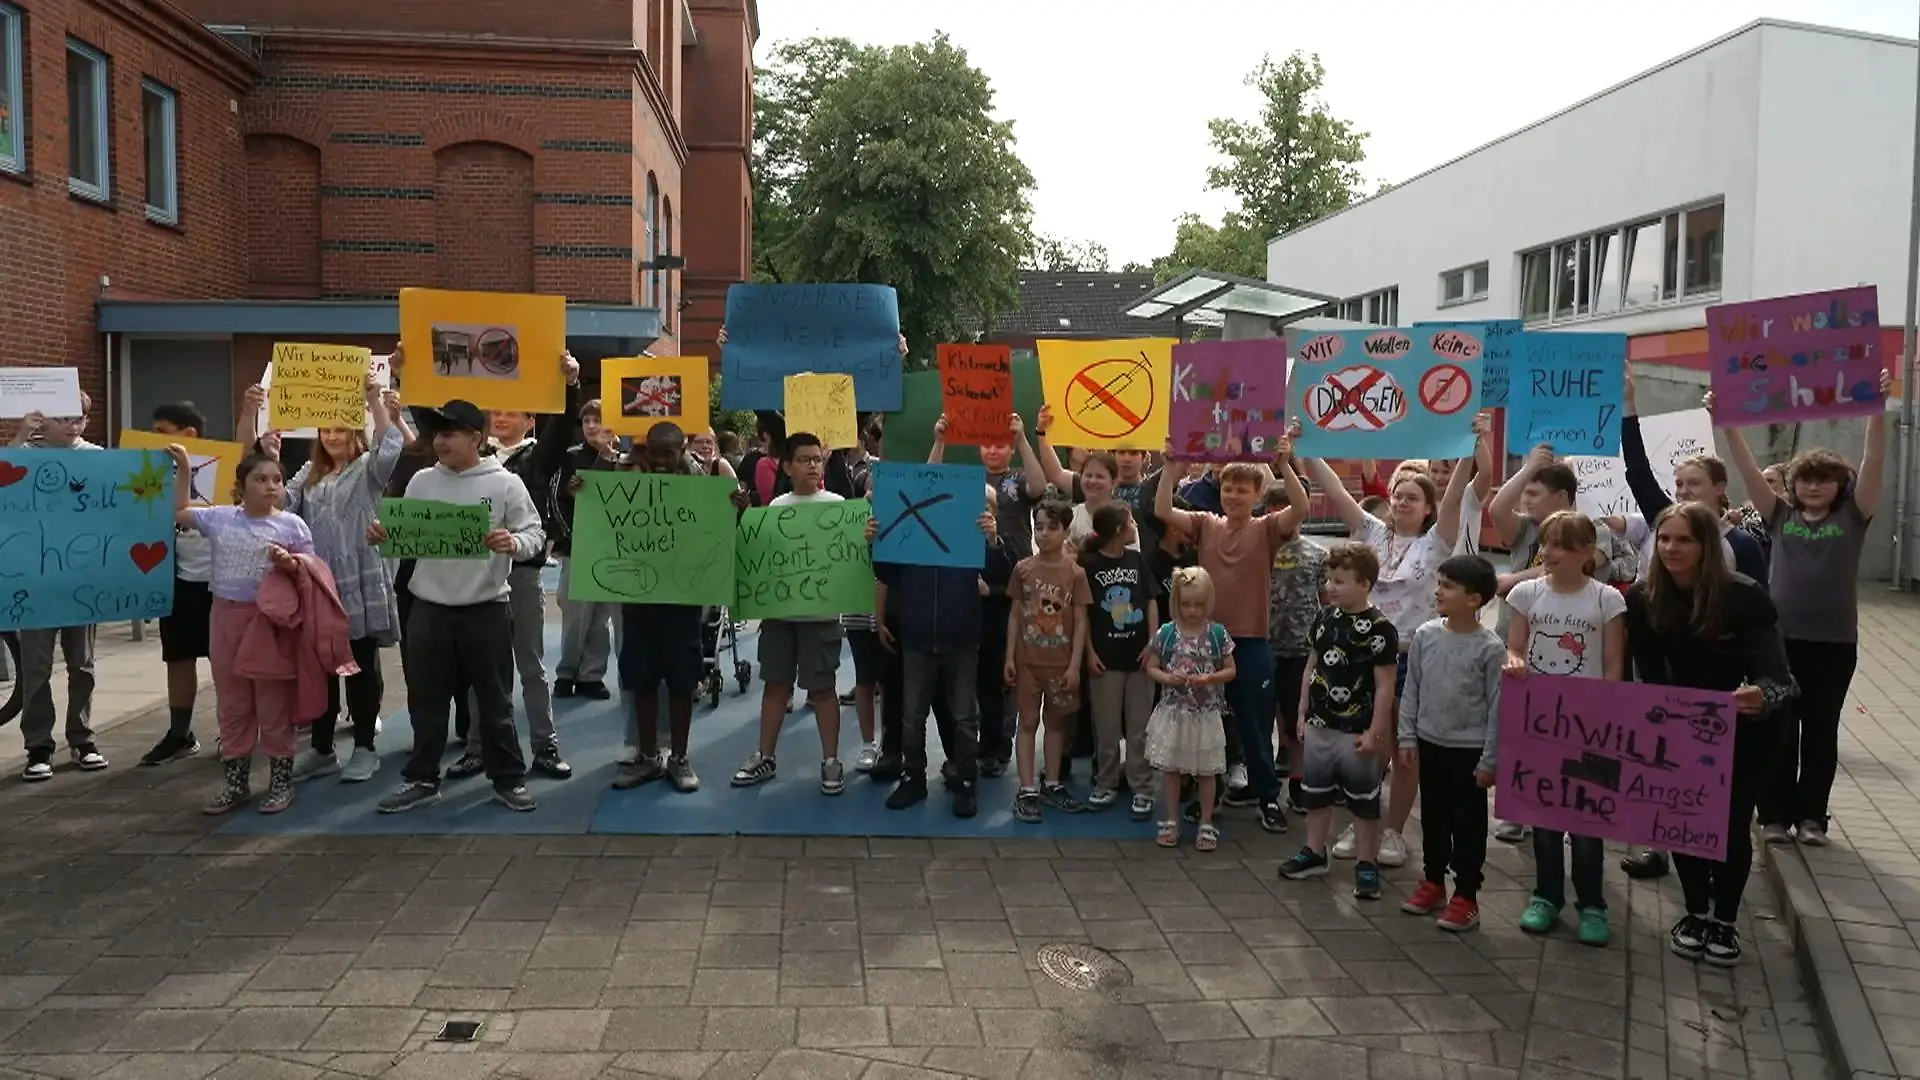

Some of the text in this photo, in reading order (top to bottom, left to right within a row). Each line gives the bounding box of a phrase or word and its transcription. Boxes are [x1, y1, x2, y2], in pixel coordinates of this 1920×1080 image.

[1719, 311, 1774, 345] Wir
[277, 345, 304, 362] Wir
[1528, 369, 1604, 398] RUHE
[1526, 421, 1586, 441] Lernen
[596, 479, 669, 507] Wir
[1524, 691, 1570, 738] Ich
[1625, 774, 1710, 808] Angst
[1652, 810, 1719, 848] haben
